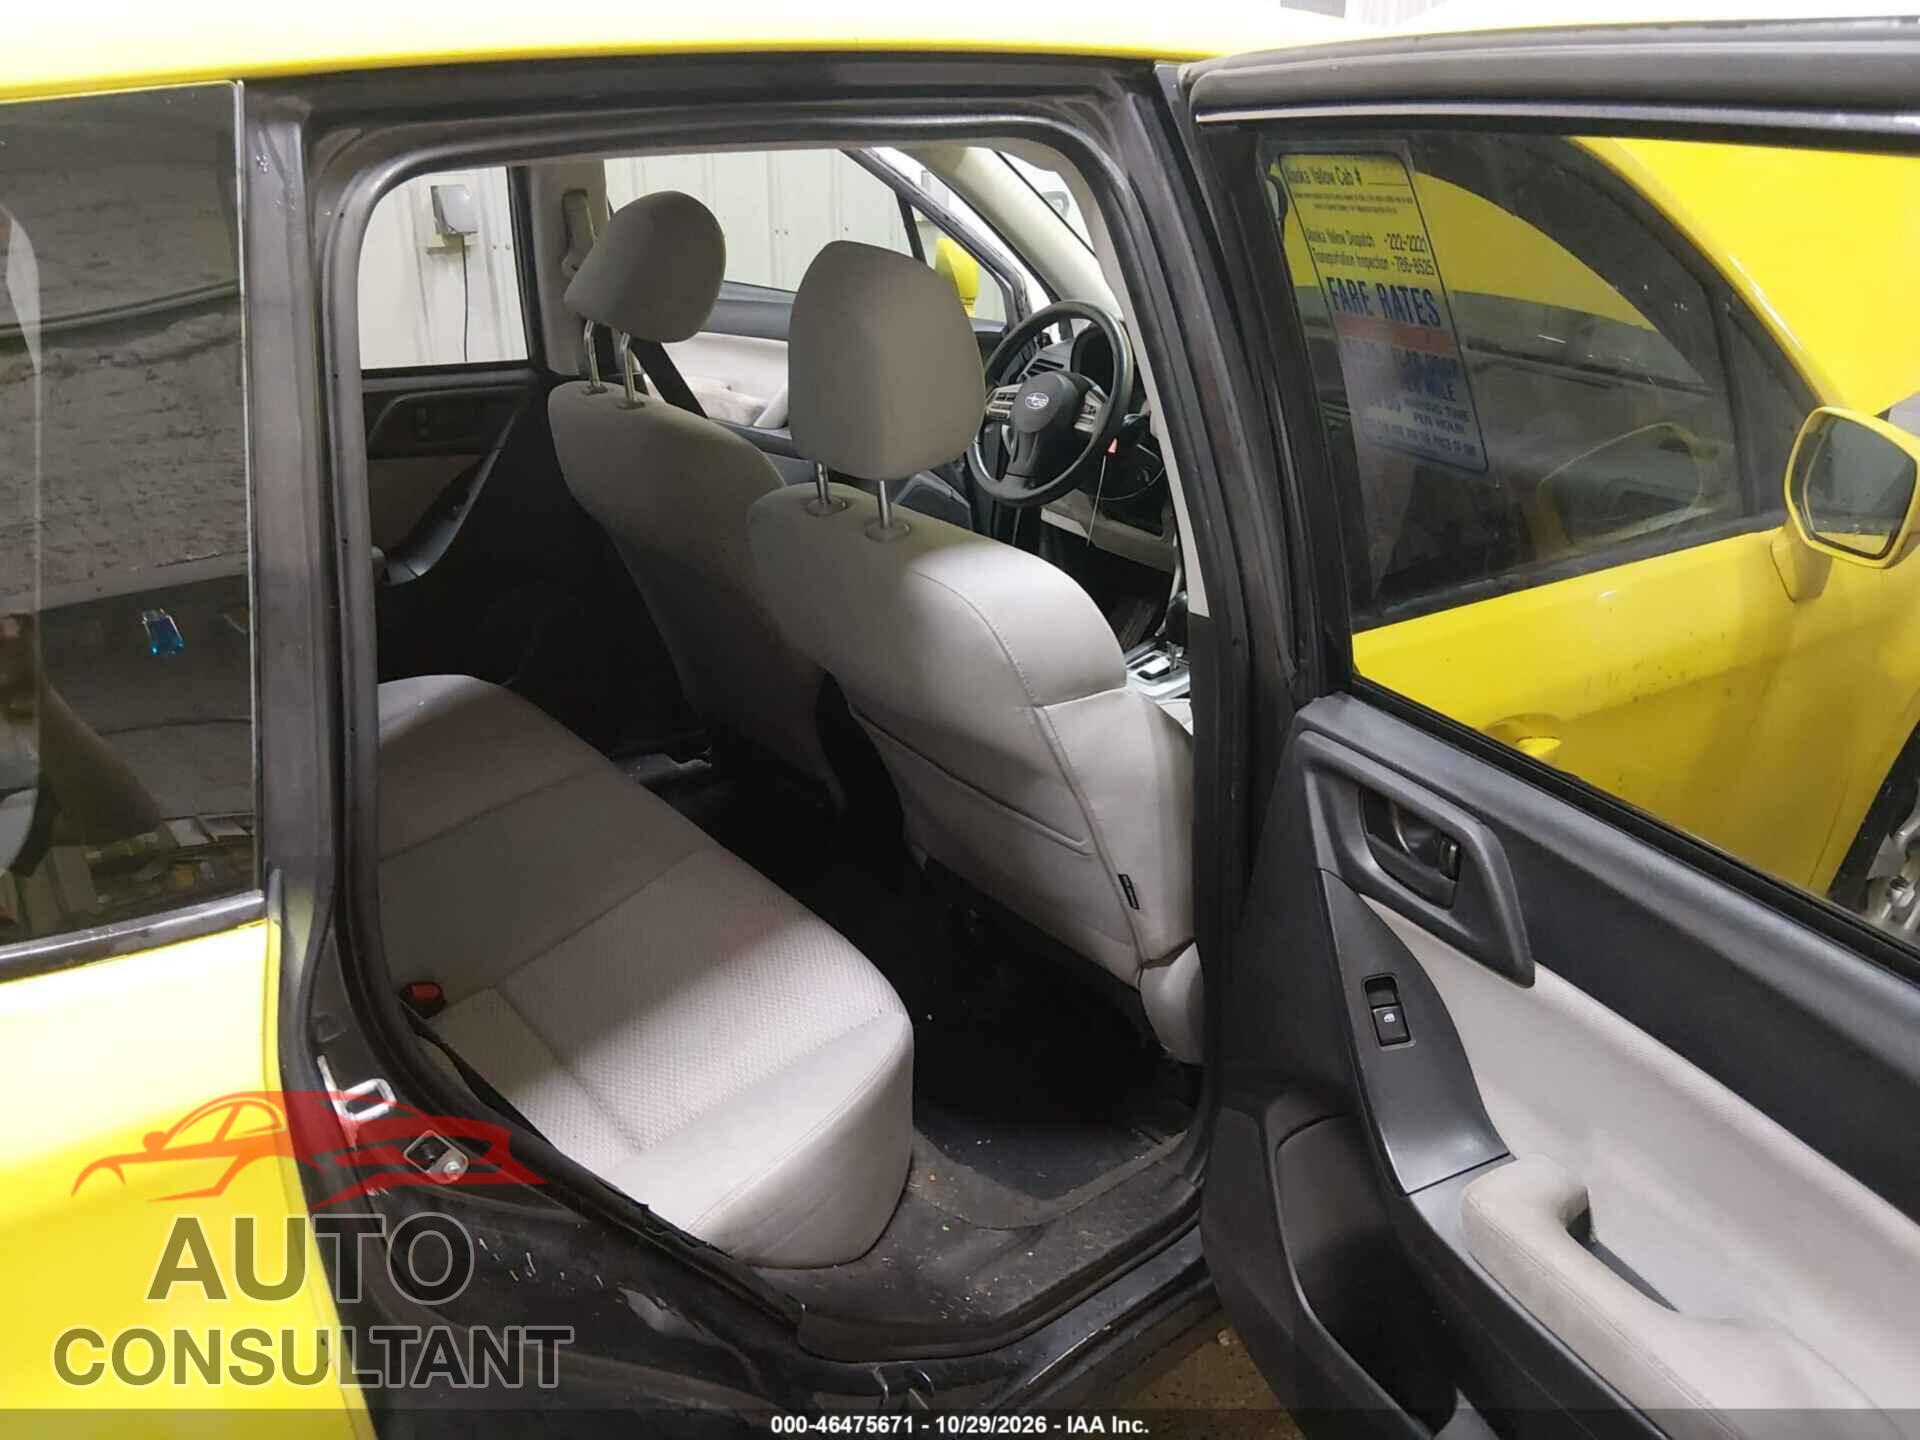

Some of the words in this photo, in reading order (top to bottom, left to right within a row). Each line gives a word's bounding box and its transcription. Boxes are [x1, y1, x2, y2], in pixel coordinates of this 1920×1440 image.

[1335, 166, 1353, 186] Cab
[1325, 276, 1375, 317] FARE
[1375, 282, 1441, 328] RATES
